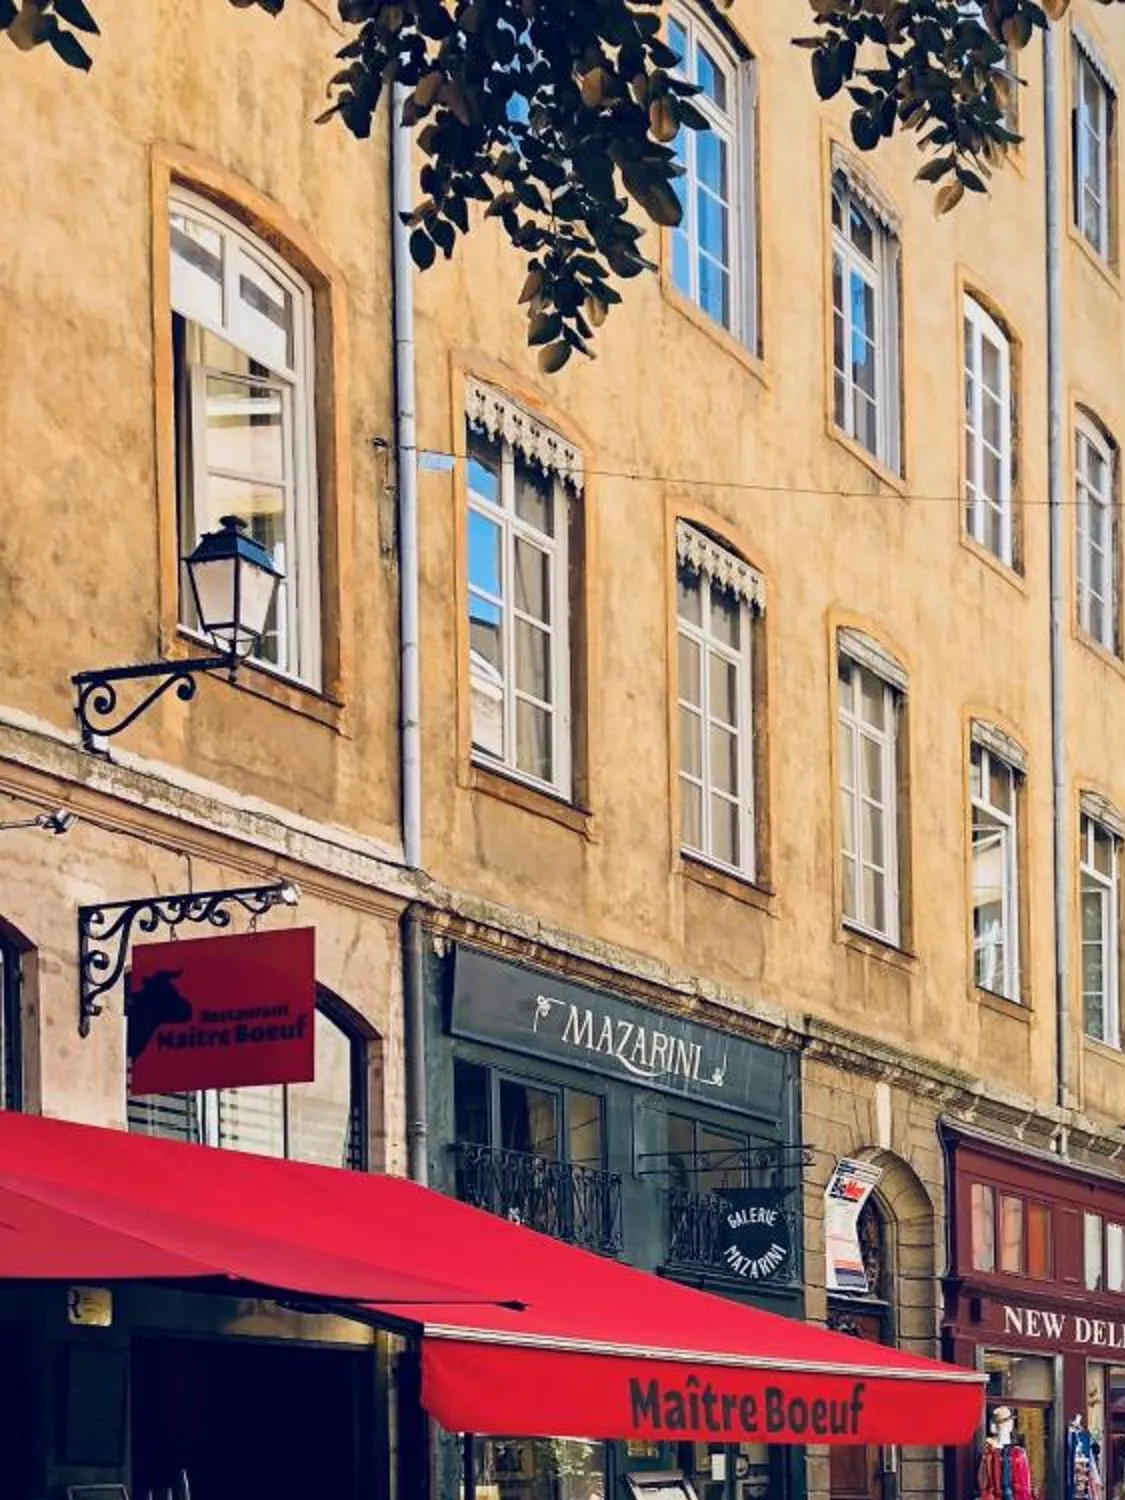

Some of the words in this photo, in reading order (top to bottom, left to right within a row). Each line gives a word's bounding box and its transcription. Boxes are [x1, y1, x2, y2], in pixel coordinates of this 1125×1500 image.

[200, 1004, 289, 1022] Restaurant
[157, 1025, 230, 1051] Maître
[235, 1014, 307, 1043] Boeuf
[561, 1004, 703, 1081] MAZARINI
[727, 1207, 779, 1229] GALERIE
[723, 1243, 787, 1279] MAZARINI
[1003, 1305, 1066, 1339] NEW
[628, 1375, 758, 1433] Maître
[764, 1382, 867, 1435] Boeuf
